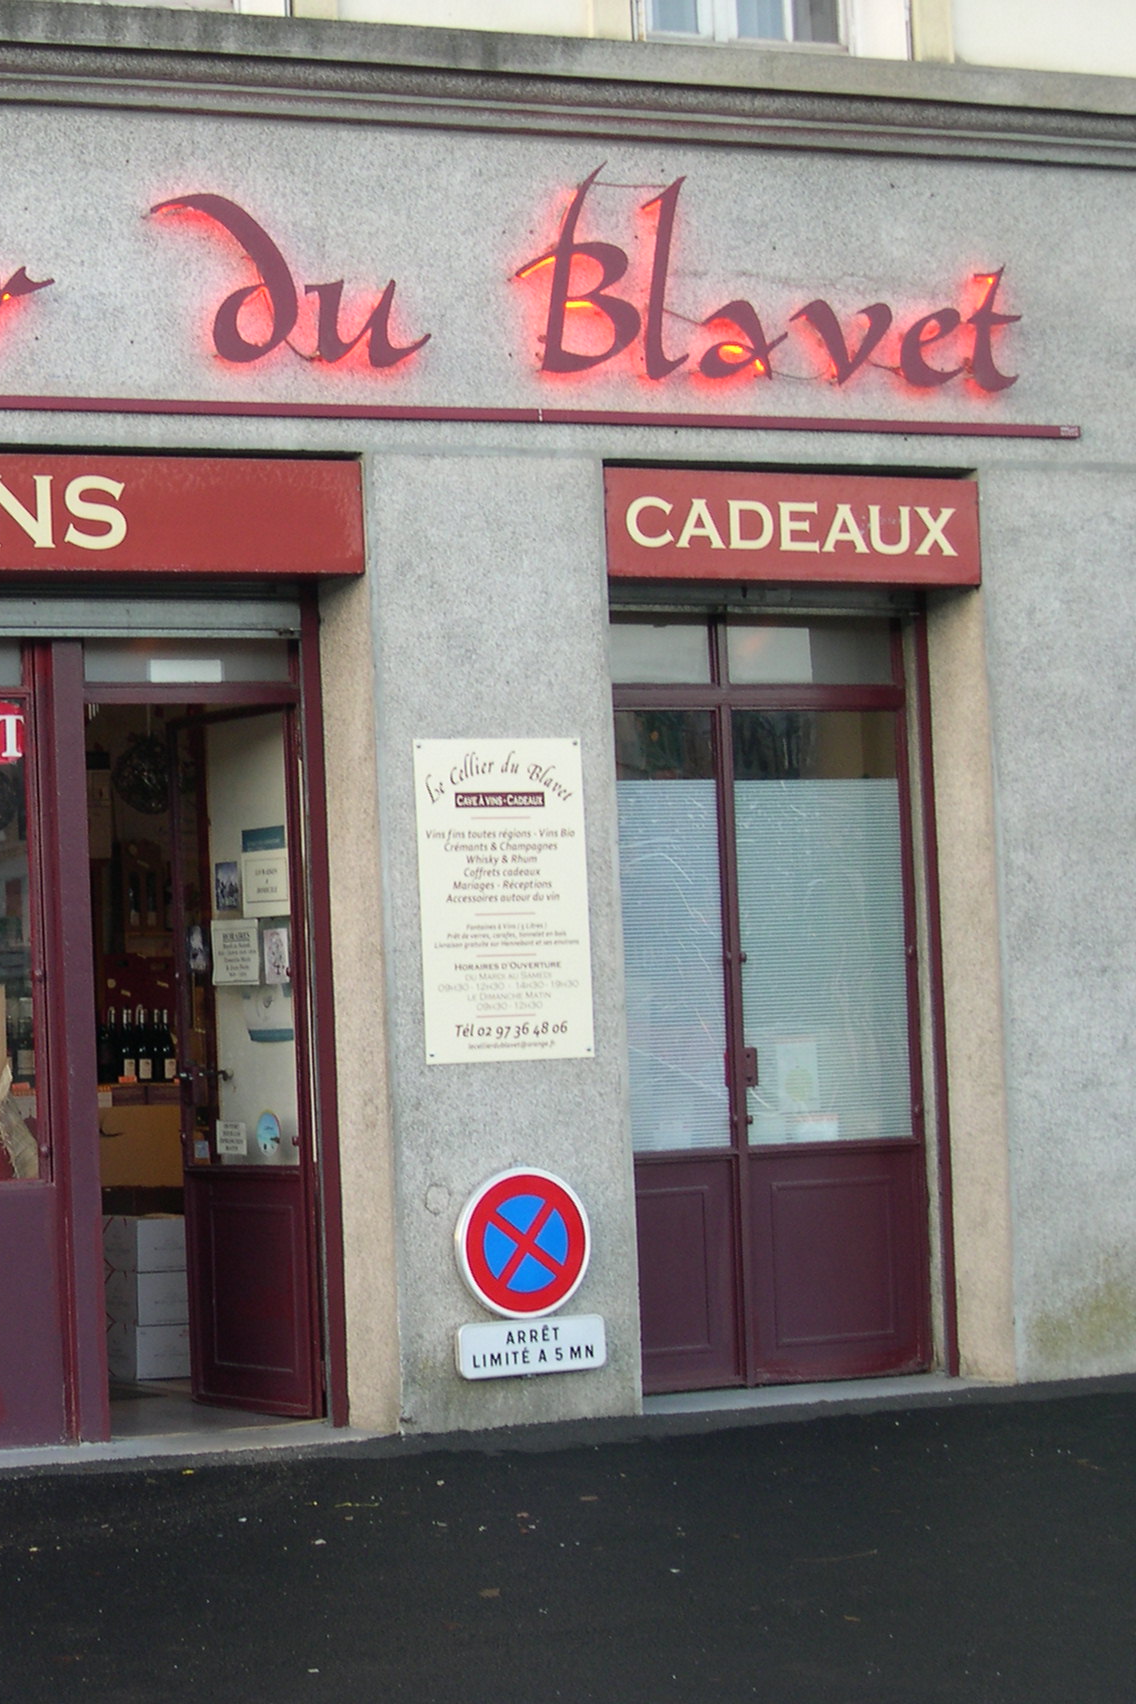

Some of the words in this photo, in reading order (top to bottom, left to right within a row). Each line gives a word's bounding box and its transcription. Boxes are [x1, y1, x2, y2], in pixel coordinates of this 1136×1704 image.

[148, 192, 431, 369] du
[509, 160, 1021, 392] Blavet
[626, 495, 958, 557] CADEAUX
[424, 774, 445, 804] Le
[450, 751, 495, 785] Cellier
[500, 750, 520, 774] du
[527, 762, 573, 802] Blavet
[425, 829, 446, 840] Vins
[446, 829, 465, 841] fins
[467, 829, 497, 839] toutes
[498, 828, 531, 841] régions
[538, 828, 558, 838] Vins
[560, 828, 576, 838] Bio
[444, 842, 488, 852] Crémants
[490, 842, 497, 852] &
[499, 841, 558, 854] Champagnes
[466, 854, 499, 866] Whisky
[500, 854, 508, 864] &
[510, 854, 538, 864] Rhum
[463, 867, 501, 879] Coffrets
[502, 868, 540, 877] cadeaux
[452, 880, 495, 892] Mariages
[502, 879, 552, 890] Réceptions
[446, 893, 498, 903] Accessoires
[500, 893, 530, 903] autour
[532, 892, 544, 902] du
[546, 892, 560, 901] vin
[454, 962, 499, 971] HORAIRES
[455, 1023, 474, 1038] Tél
[477, 1026, 492, 1037] 02
[495, 1025, 511, 1039] 97
[514, 1021, 530, 1039] 36
[532, 1020, 549, 1037] 48
[552, 1020, 568, 1034] 06
[506, 1324, 560, 1345] ARRÊT
[472, 1347, 530, 1368] LIMITÉ
[538, 1349, 547, 1363] A
[555, 1347, 564, 1361] 5
[570, 1344, 595, 1360] MN
